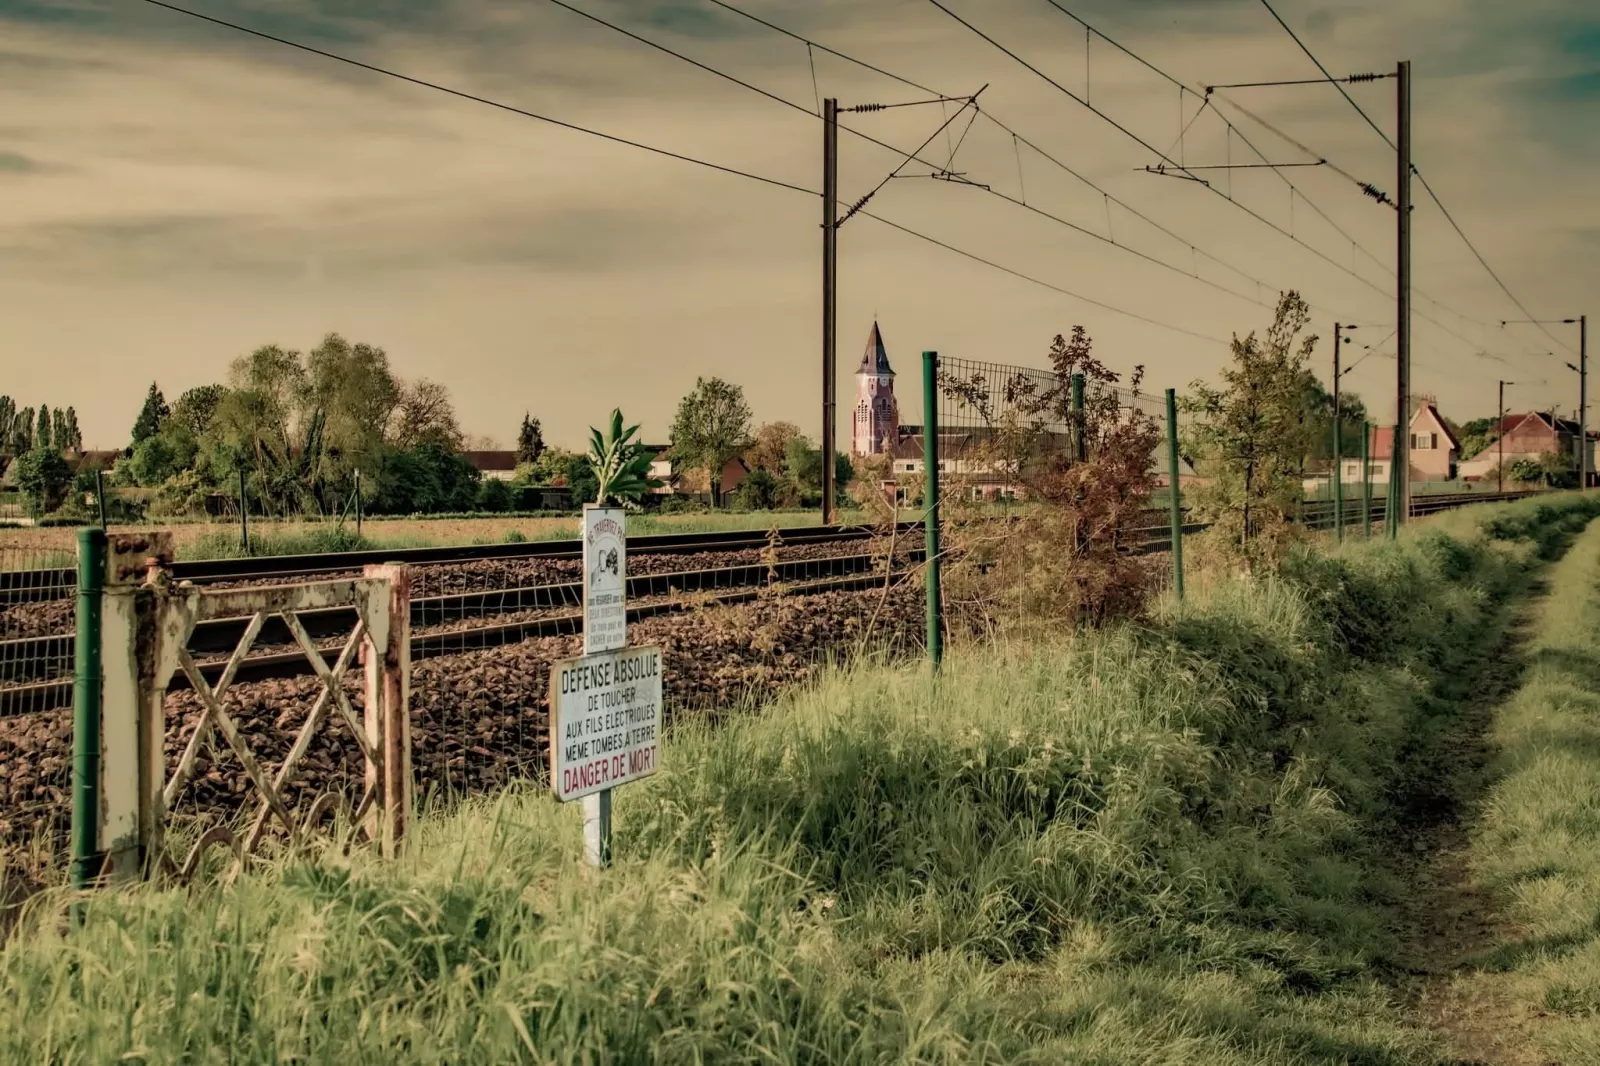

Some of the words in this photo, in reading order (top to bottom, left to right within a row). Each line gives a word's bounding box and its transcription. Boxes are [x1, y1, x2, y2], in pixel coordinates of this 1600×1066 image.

[613, 654, 658, 685] ABSOLUE
[588, 694, 599, 712] DE
[600, 686, 636, 709] TOUCHER
[566, 720, 583, 741] AUX
[585, 715, 603, 734] FILS
[631, 725, 655, 745] TERRE
[563, 758, 609, 794] DANGER
[612, 754, 626, 780] DE
[628, 745, 657, 775] MORT
